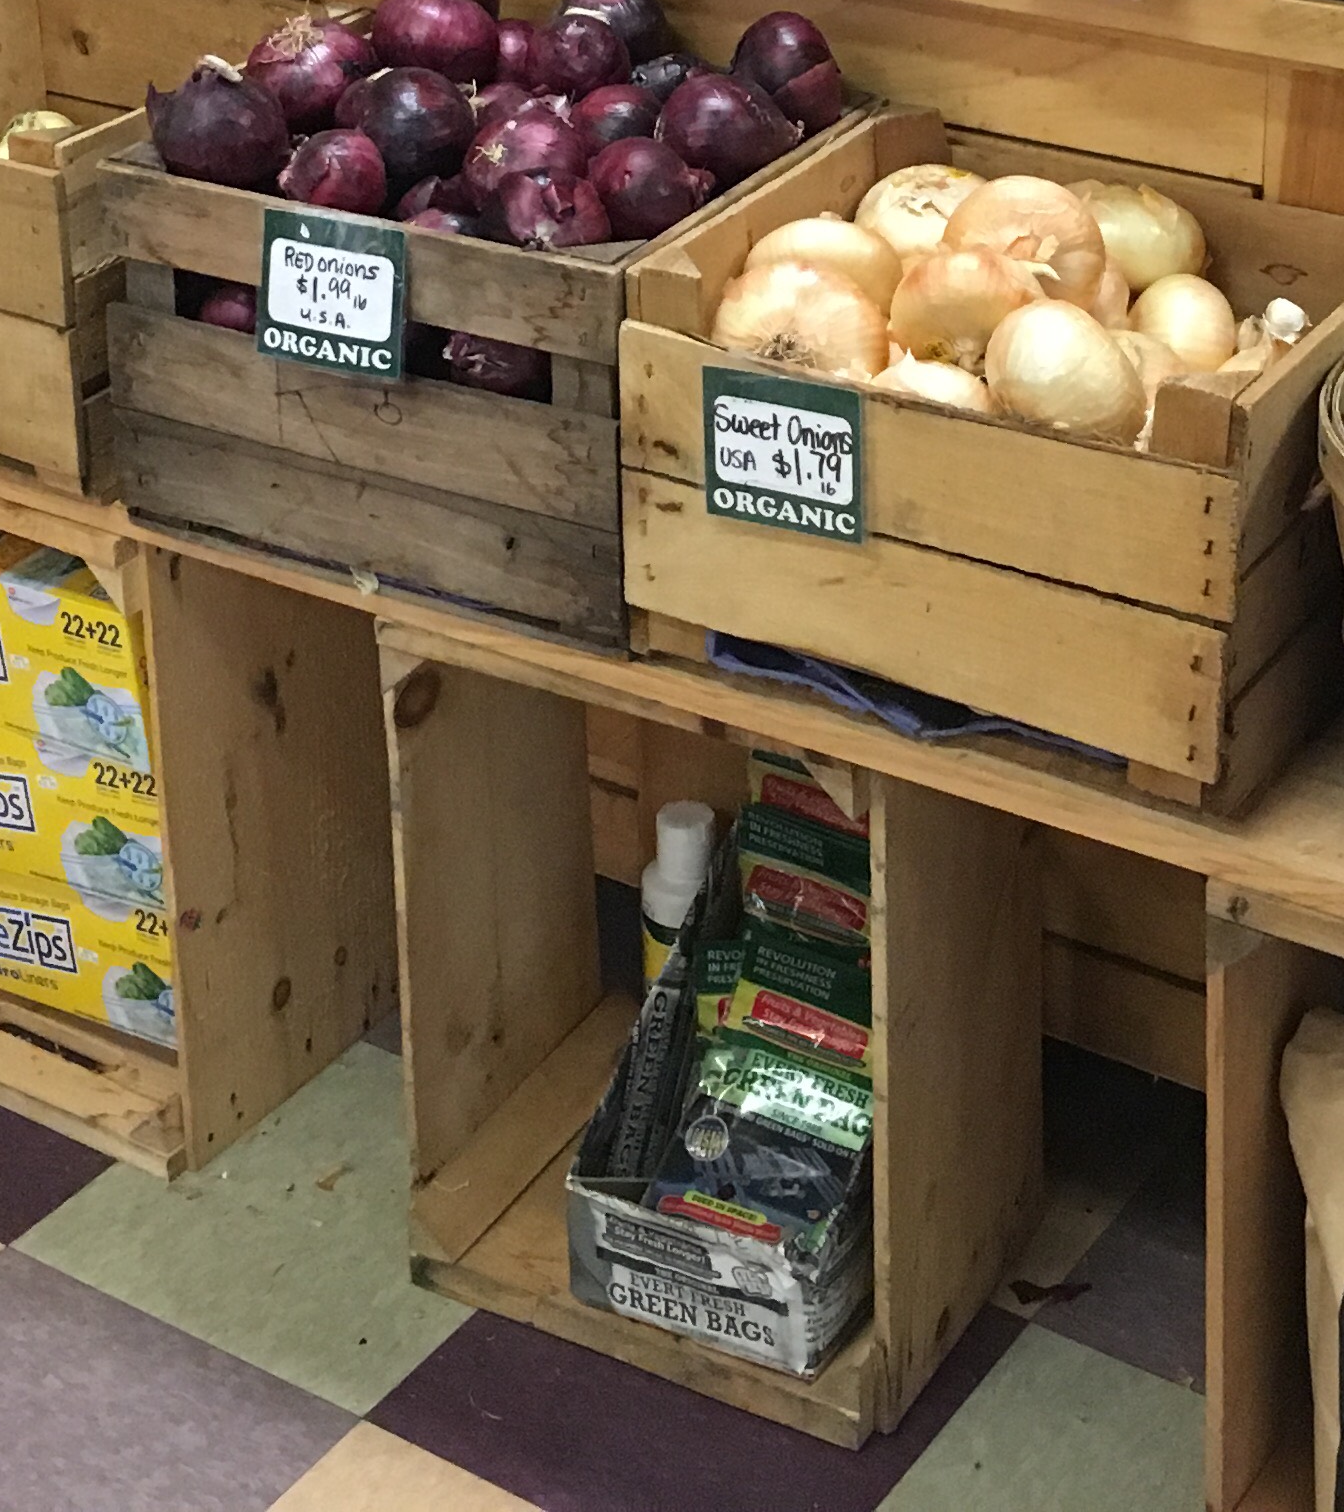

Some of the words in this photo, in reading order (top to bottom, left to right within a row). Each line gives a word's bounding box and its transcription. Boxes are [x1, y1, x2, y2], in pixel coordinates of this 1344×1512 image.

[284, 245, 314, 273] RED
[317, 256, 380, 281] onions
[296, 274, 351, 303] $1.99
[263, 326, 392, 371] ORGANIC
[713, 402, 782, 441] Sweet
[787, 414, 854, 456] Onions
[720, 445, 757, 472] USA
[771, 448, 842, 486] $1.79
[713, 487, 856, 536] ORGANIC
[61, 610, 123, 648] 22+22
[92, 761, 158, 798] 22+22
[608, 1282, 698, 1327] GREEN
[704, 1308, 777, 1348] BAGS
[690, 1286, 747, 1317] FRESH
